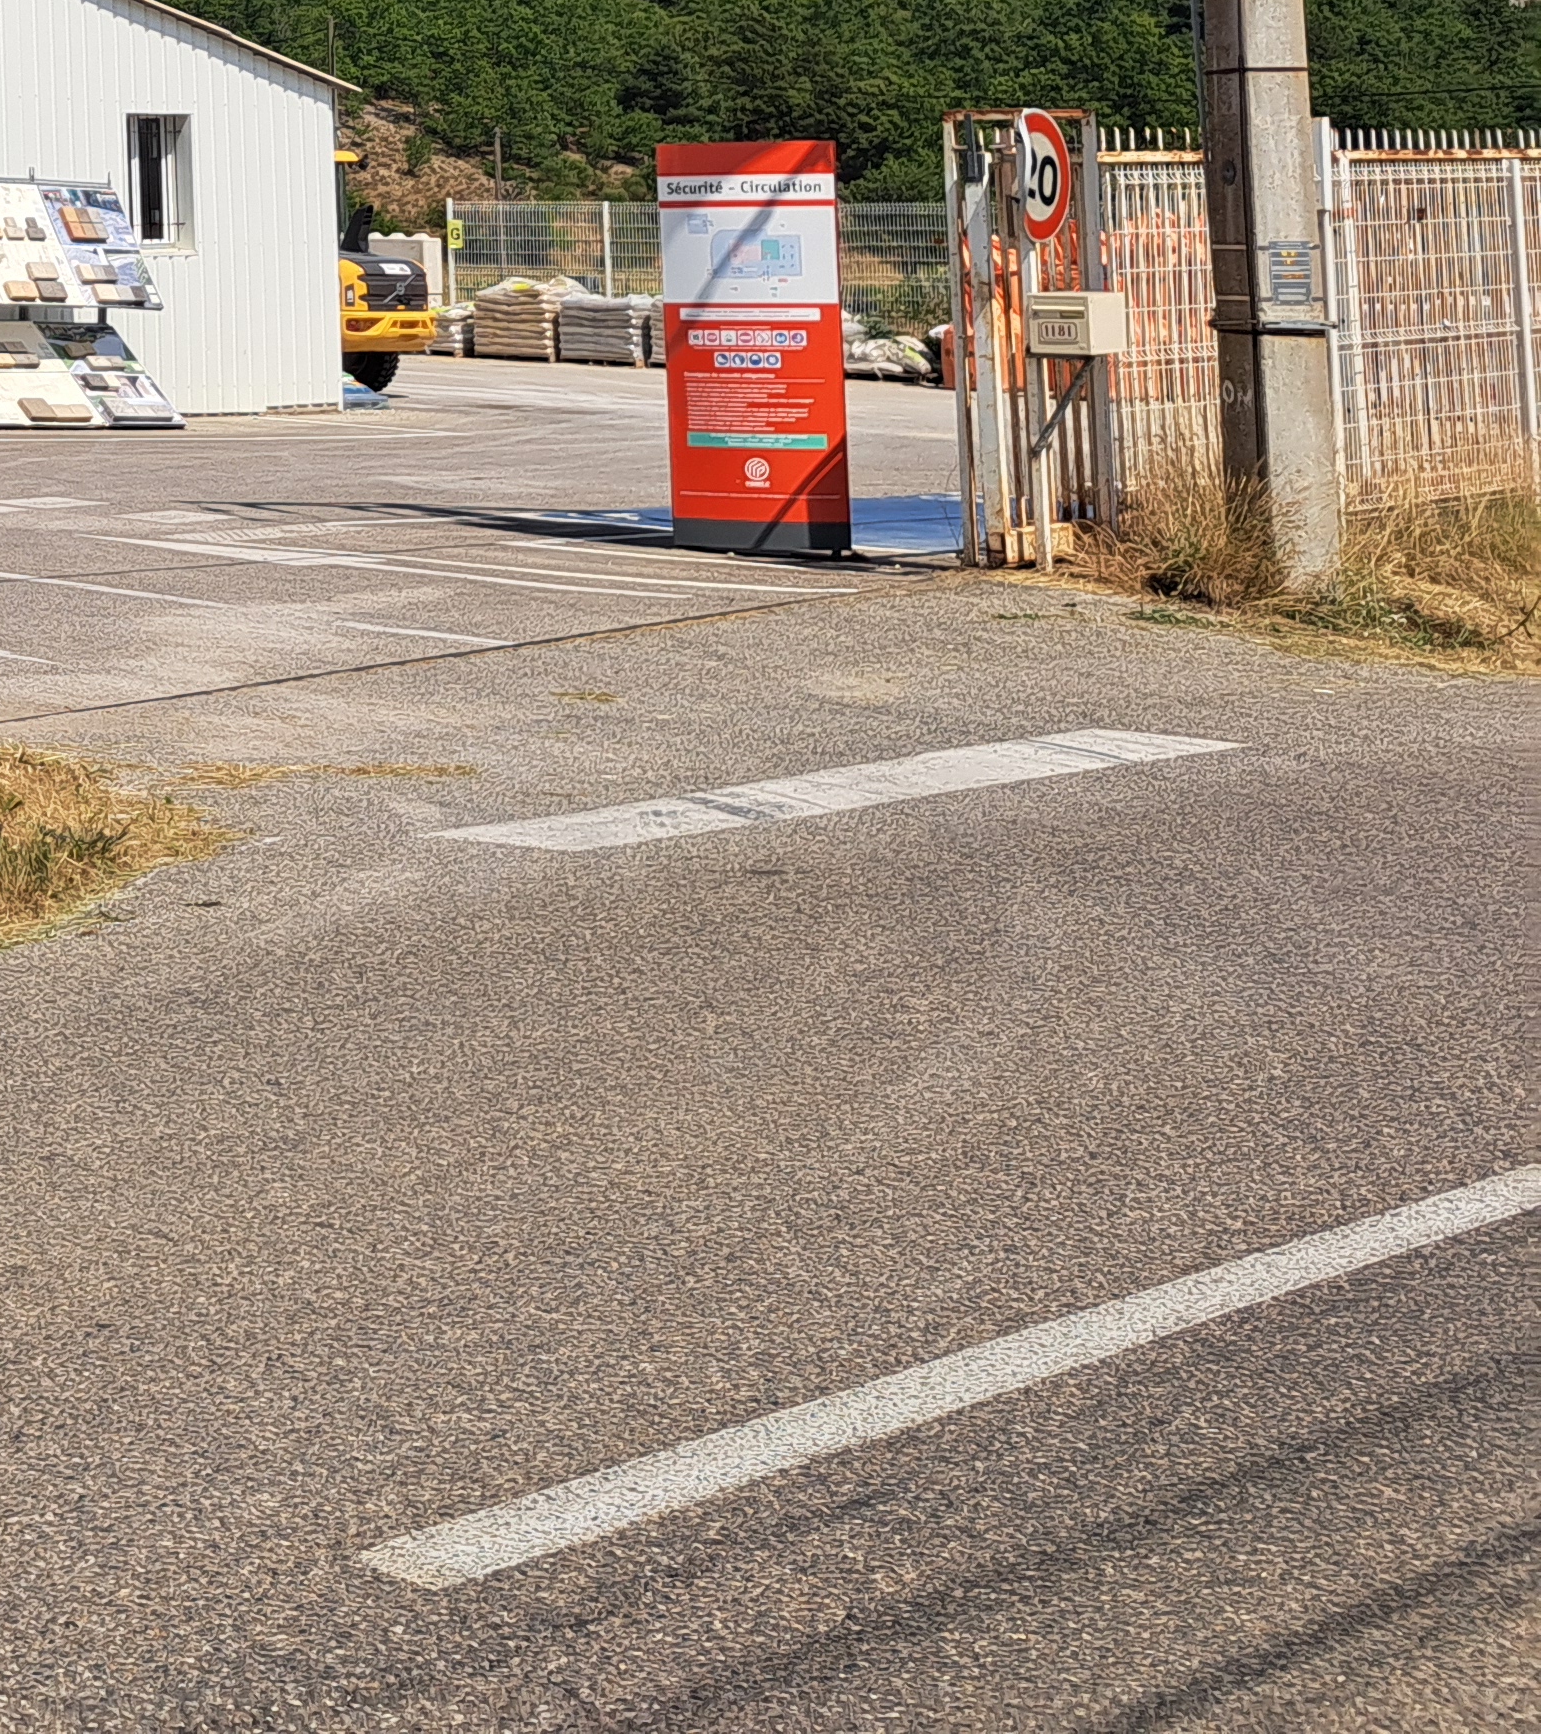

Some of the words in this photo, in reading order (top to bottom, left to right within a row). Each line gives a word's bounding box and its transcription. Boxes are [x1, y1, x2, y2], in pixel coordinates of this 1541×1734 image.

[667, 180, 723, 195] Sécurité
[741, 178, 822, 193] Circulation
[450, 227, 461, 241] G
